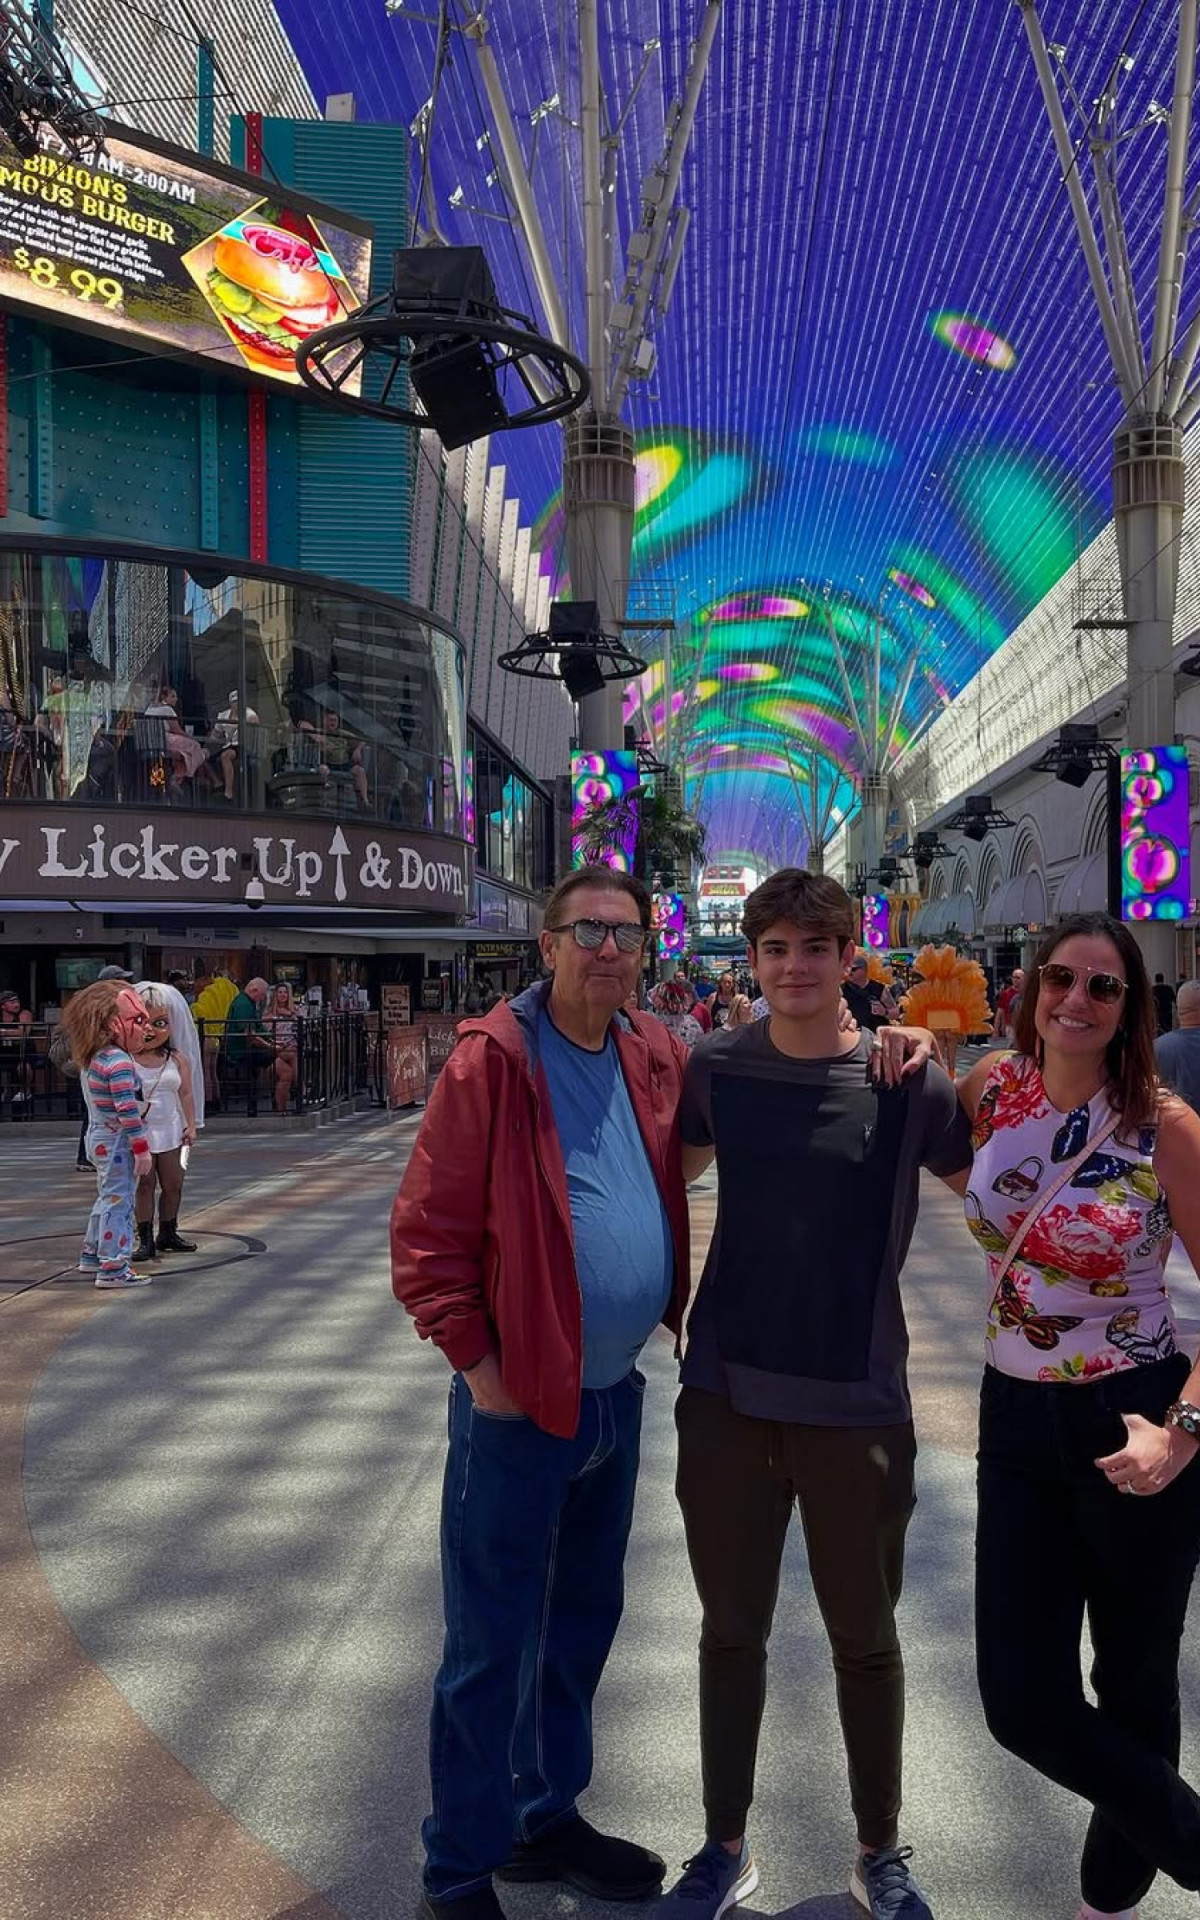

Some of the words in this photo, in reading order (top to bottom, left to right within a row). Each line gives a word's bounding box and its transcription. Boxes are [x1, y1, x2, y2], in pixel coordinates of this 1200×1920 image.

[26, 212, 36, 224] to
[36, 218, 61, 231] order
[105, 239, 120, 253] top
[82, 194, 176, 246] BURGER
[74, 241, 116, 261] garnished
[109, 231, 126, 243] and
[56, 247, 74, 259] and
[38, 824, 238, 883] Licker
[253, 837, 323, 897] Up
[359, 841, 392, 890] &
[398, 847, 463, 896] Down
